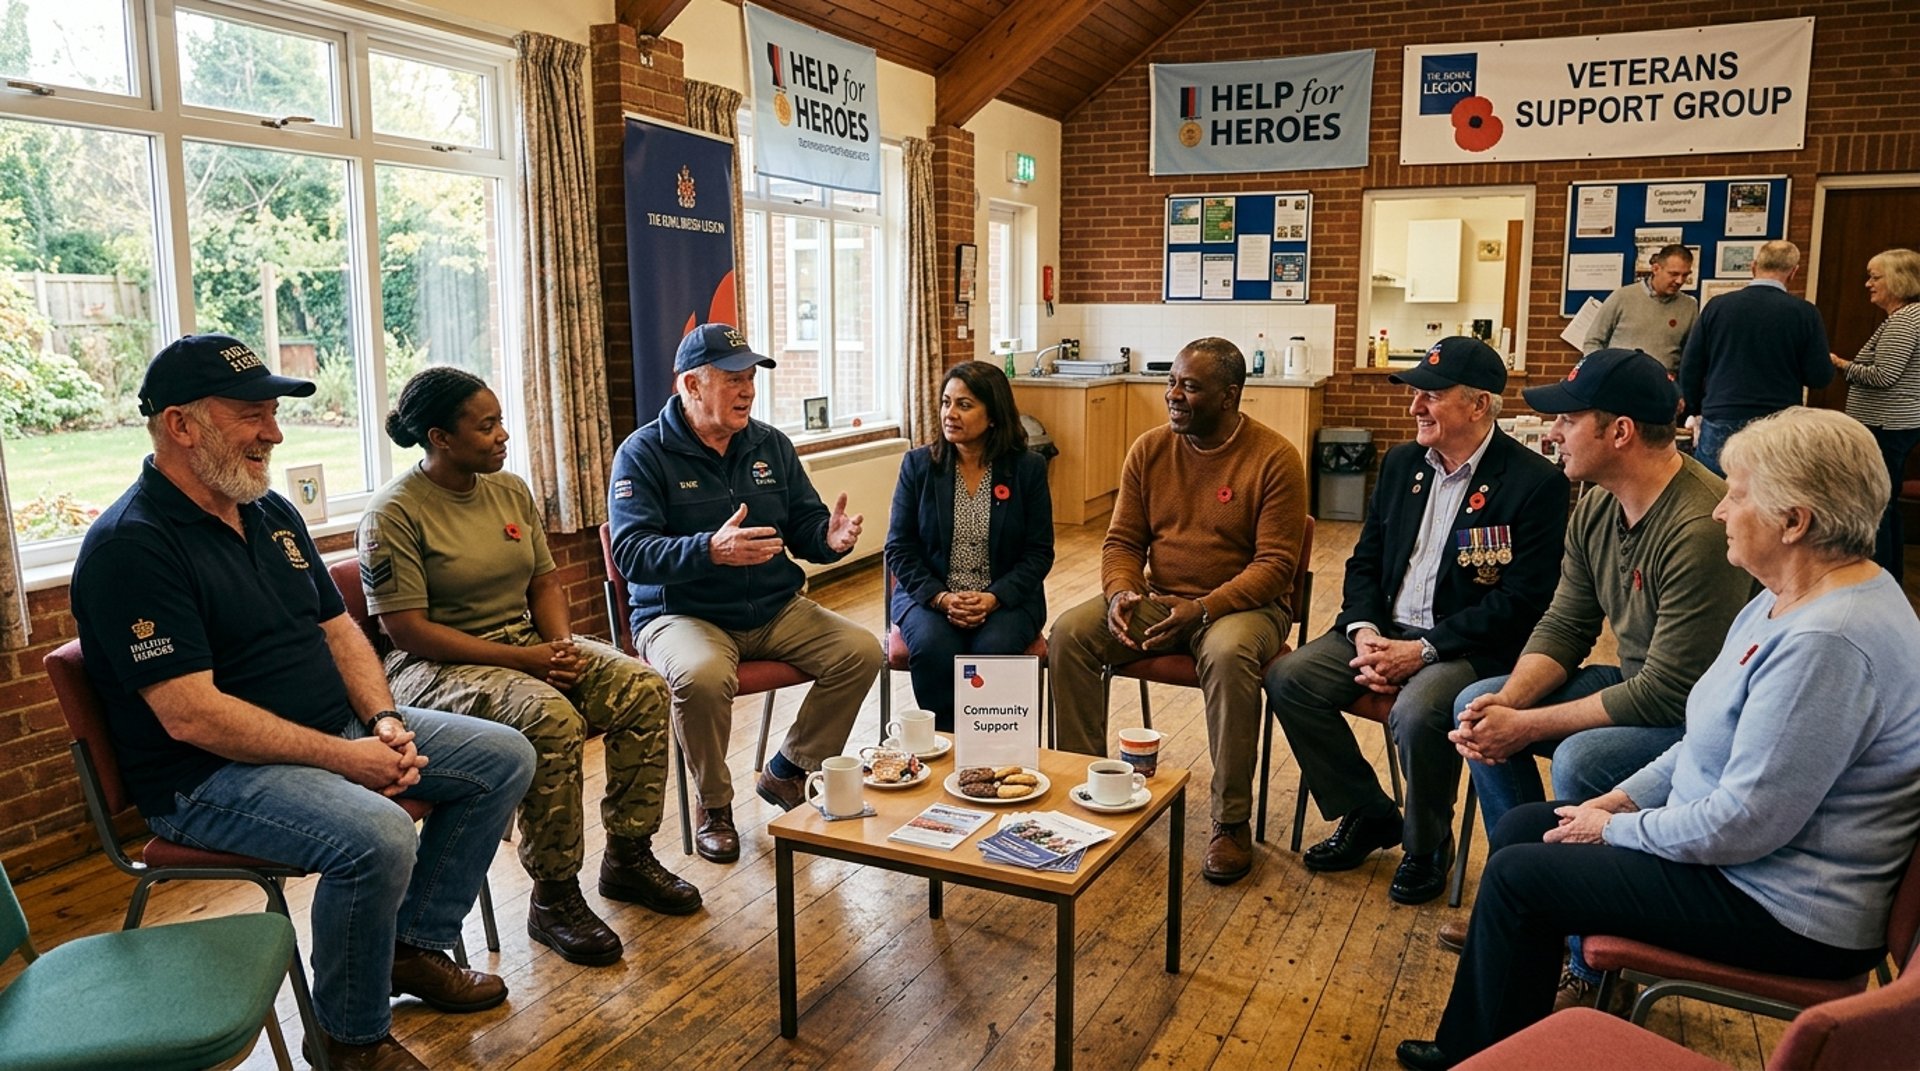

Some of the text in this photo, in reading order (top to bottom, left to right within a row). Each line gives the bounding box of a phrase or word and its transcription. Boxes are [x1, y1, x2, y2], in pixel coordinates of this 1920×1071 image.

[790, 51, 866, 106] HELP for
[1567, 51, 1739, 89] VETERANS
[1211, 78, 1344, 113] HELP for
[1423, 81, 1473, 95] LEGION
[795, 95, 869, 143] HEROES
[1515, 86, 1792, 128] SUPPORT GROUP
[1211, 113, 1341, 146] HEROES
[963, 705, 1029, 718] Community
[973, 720, 1019, 733] Support
